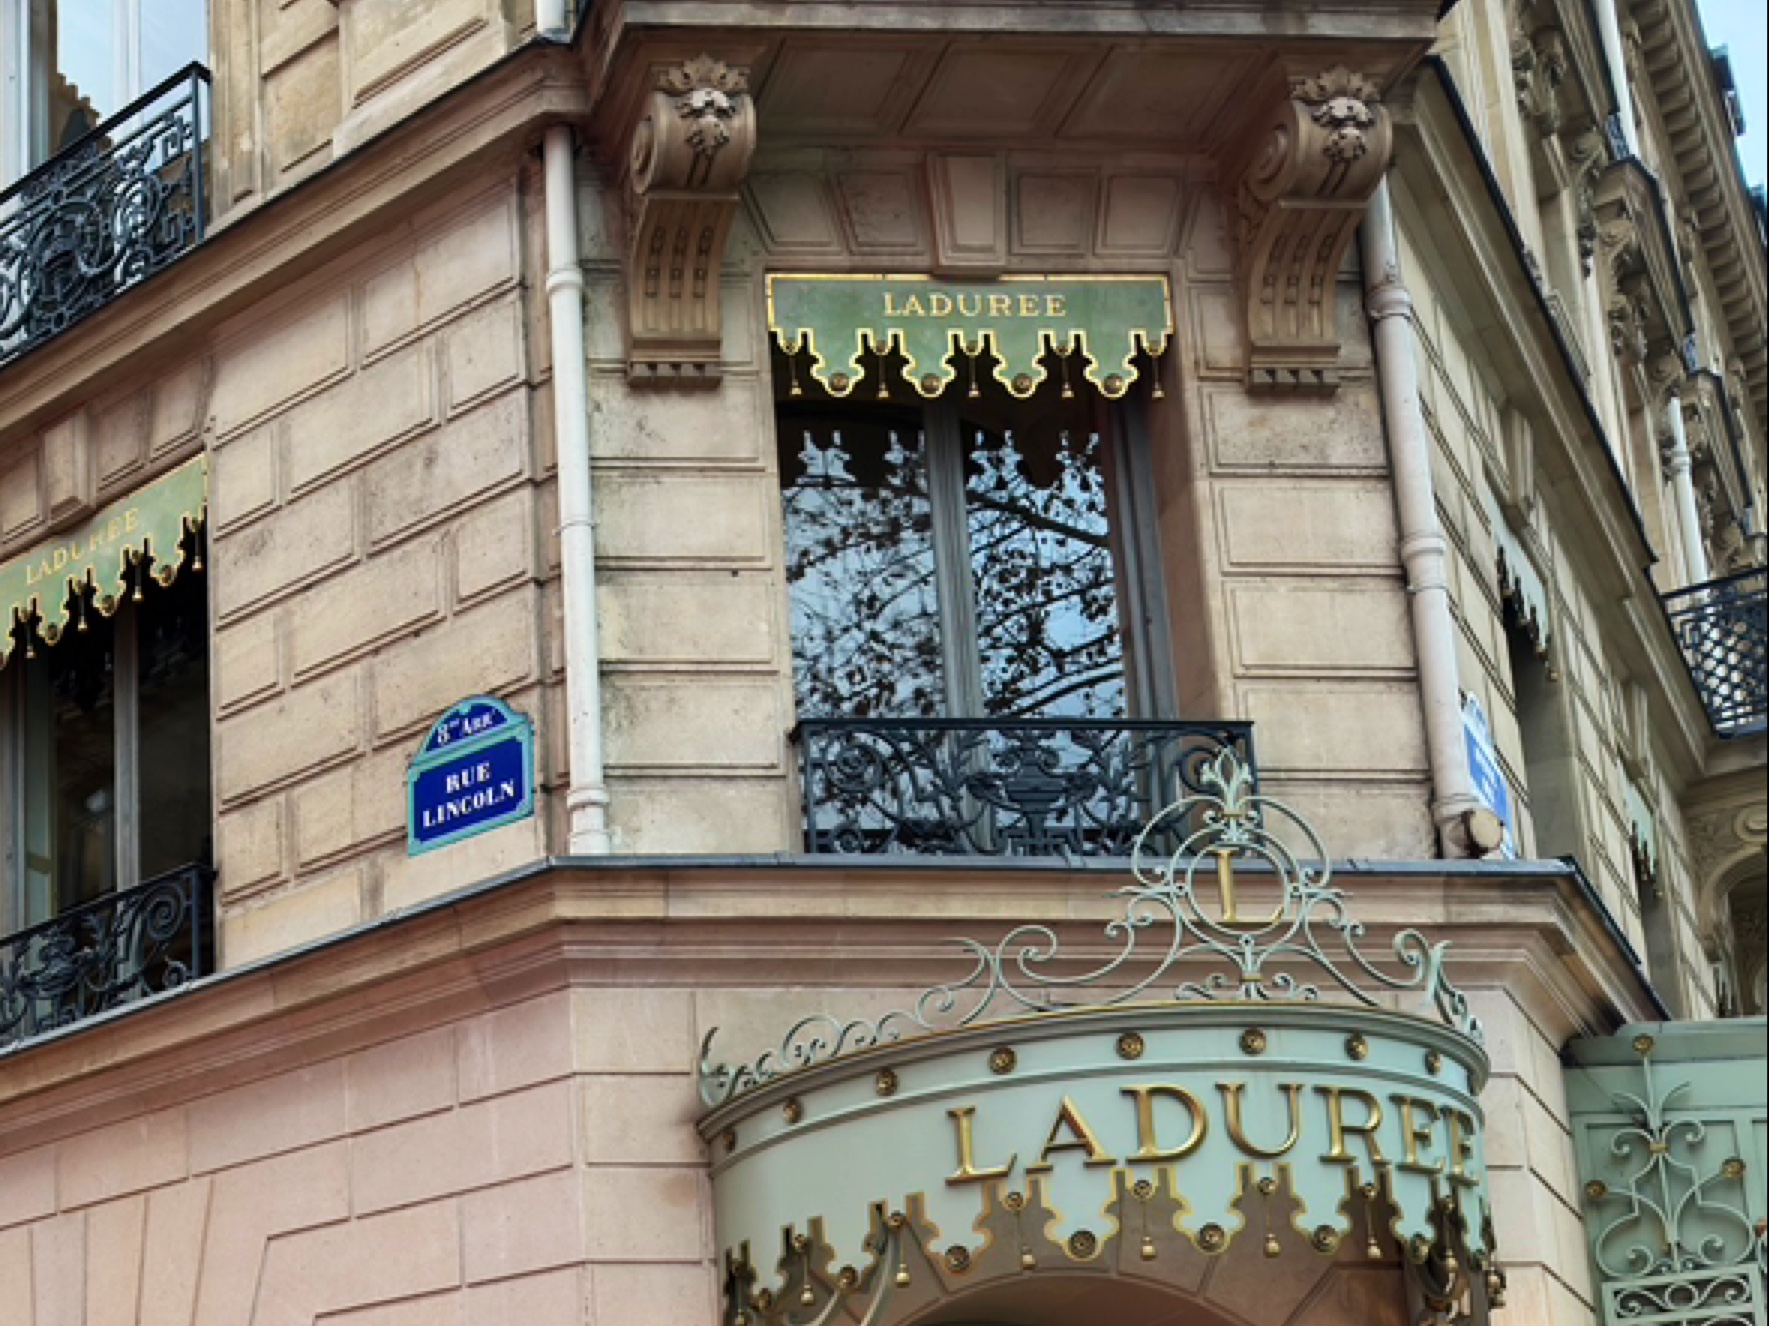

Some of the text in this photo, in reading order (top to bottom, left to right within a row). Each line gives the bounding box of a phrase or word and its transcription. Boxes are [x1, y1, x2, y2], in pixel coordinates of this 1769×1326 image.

[883, 291, 1067, 317] LADUREE
[445, 760, 491, 794] RUE
[422, 777, 515, 828] LINCOLN
[944, 1082, 1480, 1187] LADUREE
